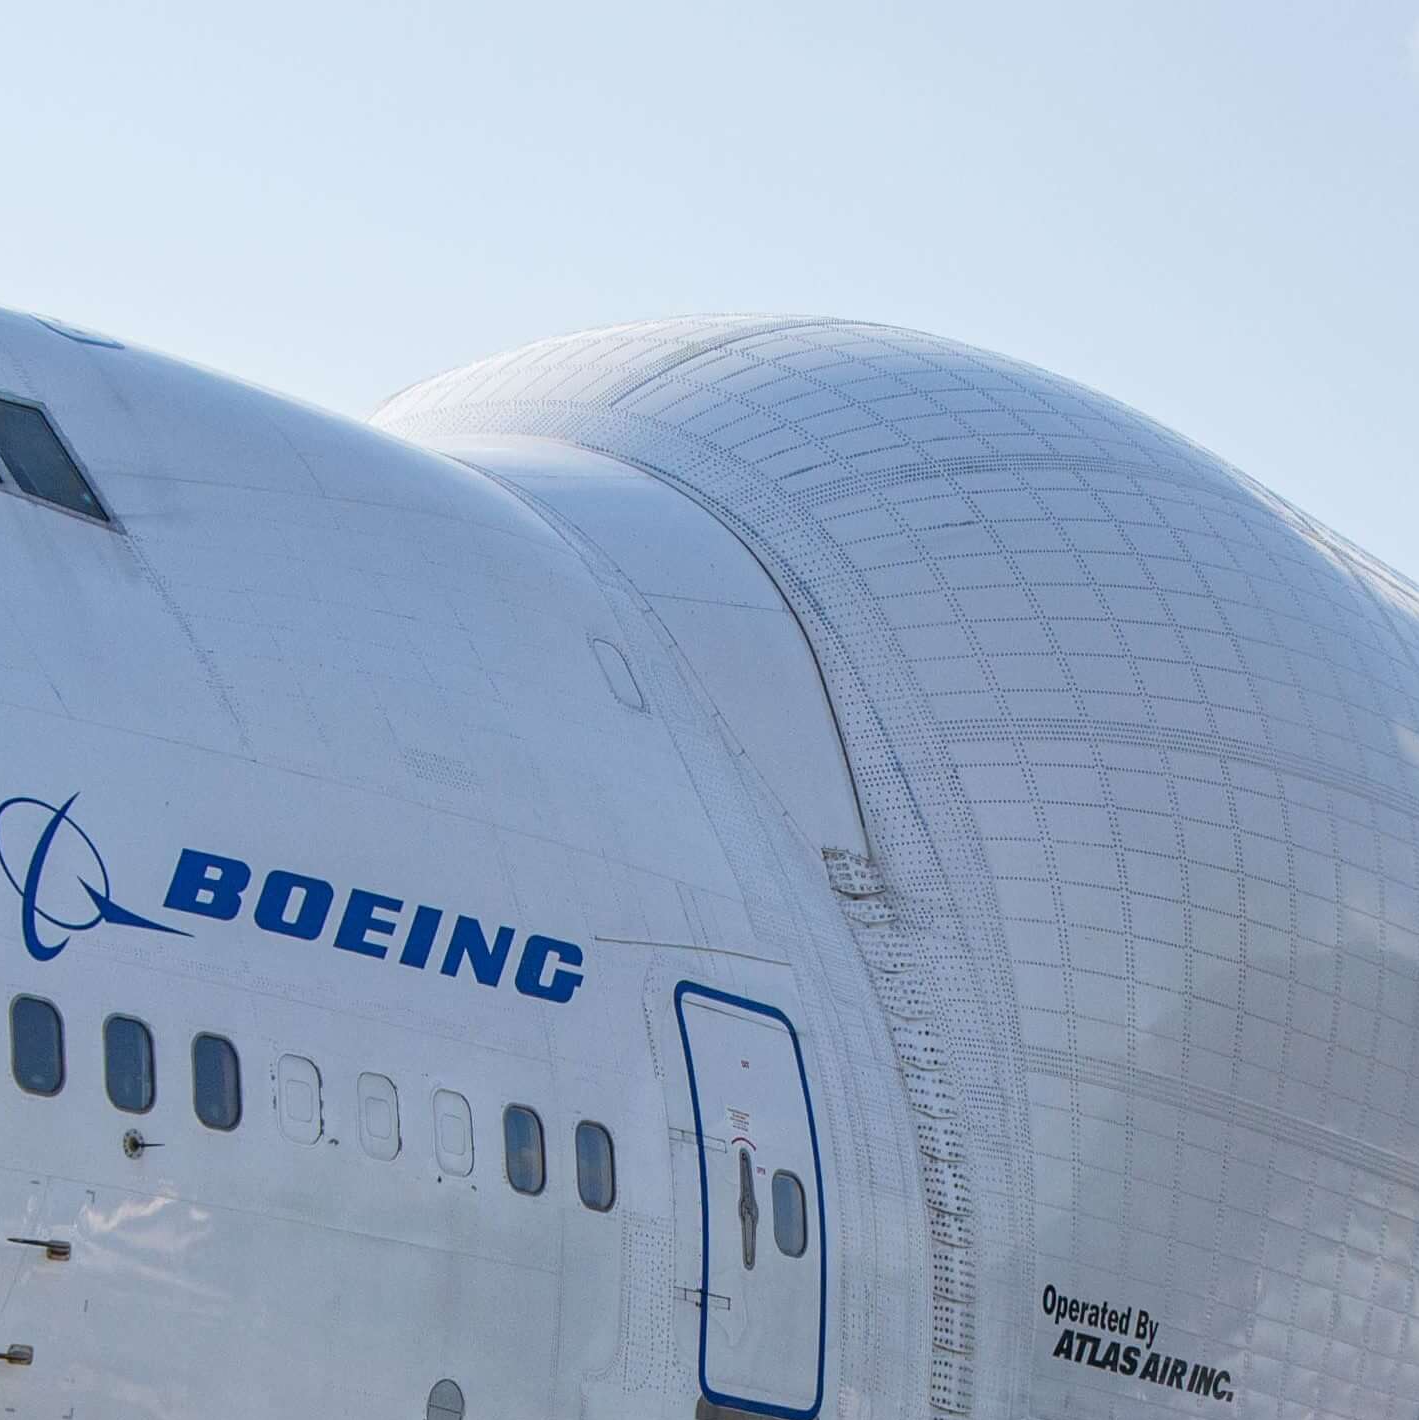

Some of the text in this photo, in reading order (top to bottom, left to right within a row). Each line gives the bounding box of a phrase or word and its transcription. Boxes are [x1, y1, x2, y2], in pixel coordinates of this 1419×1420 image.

[163, 848, 585, 1004] BOEING
[1042, 1284, 1159, 1349] Operated By
[1053, 1328, 1235, 1402] ATLAS AIR INC.
